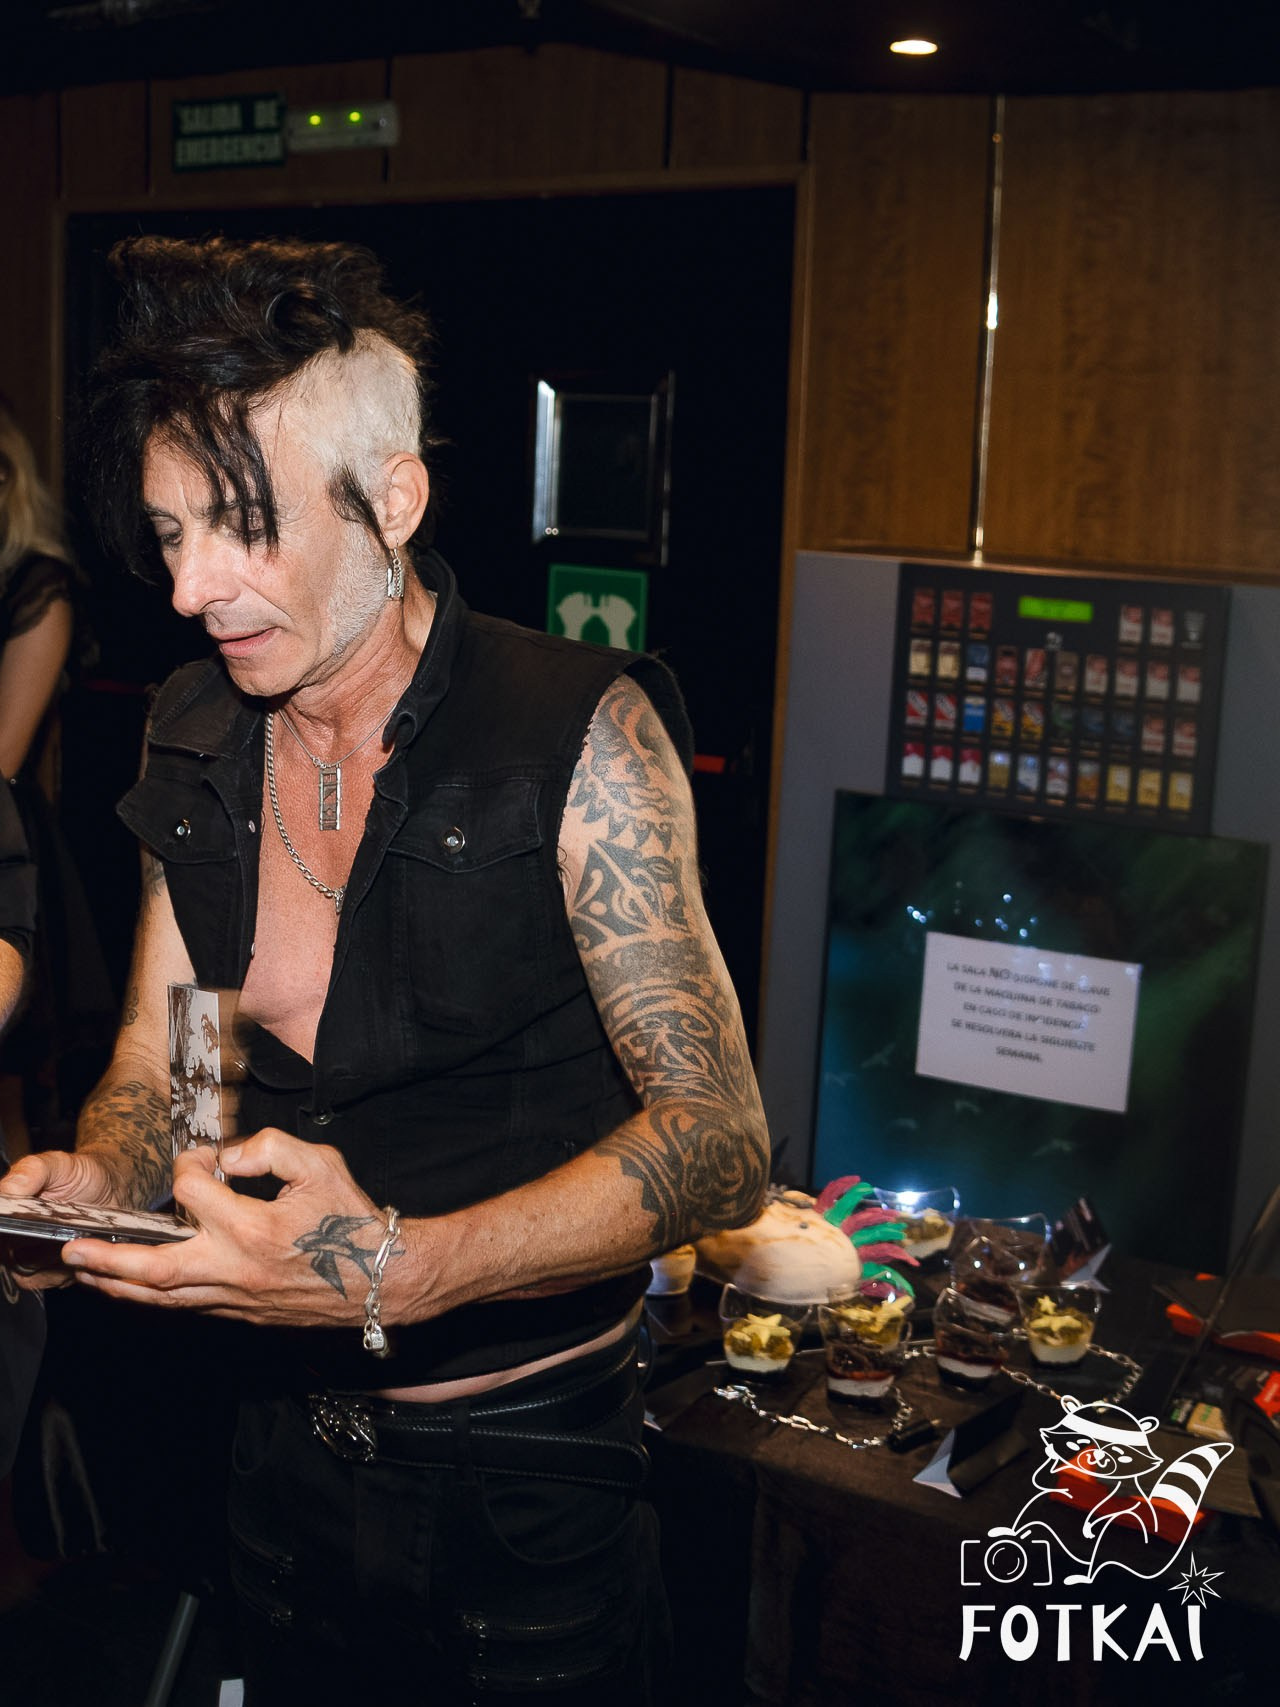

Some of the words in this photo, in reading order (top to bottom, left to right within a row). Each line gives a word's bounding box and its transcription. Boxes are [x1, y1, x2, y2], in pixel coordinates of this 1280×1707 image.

[254, 99, 276, 127] DE
[947, 962, 959, 972] LA
[962, 964, 986, 977] SALA
[989, 966, 1011, 980] NO
[1061, 980, 1076, 991] DE
[954, 981, 967, 992] DE
[969, 984, 982, 995] LA
[1039, 996, 1053, 1007] DE
[963, 1001, 976, 1011] EN
[978, 1005, 1007, 1017] CASO
[1008, 1010, 1022, 1021] DE
[951, 1018, 962, 1028] SE
[1024, 1032, 1039, 1042] LA
